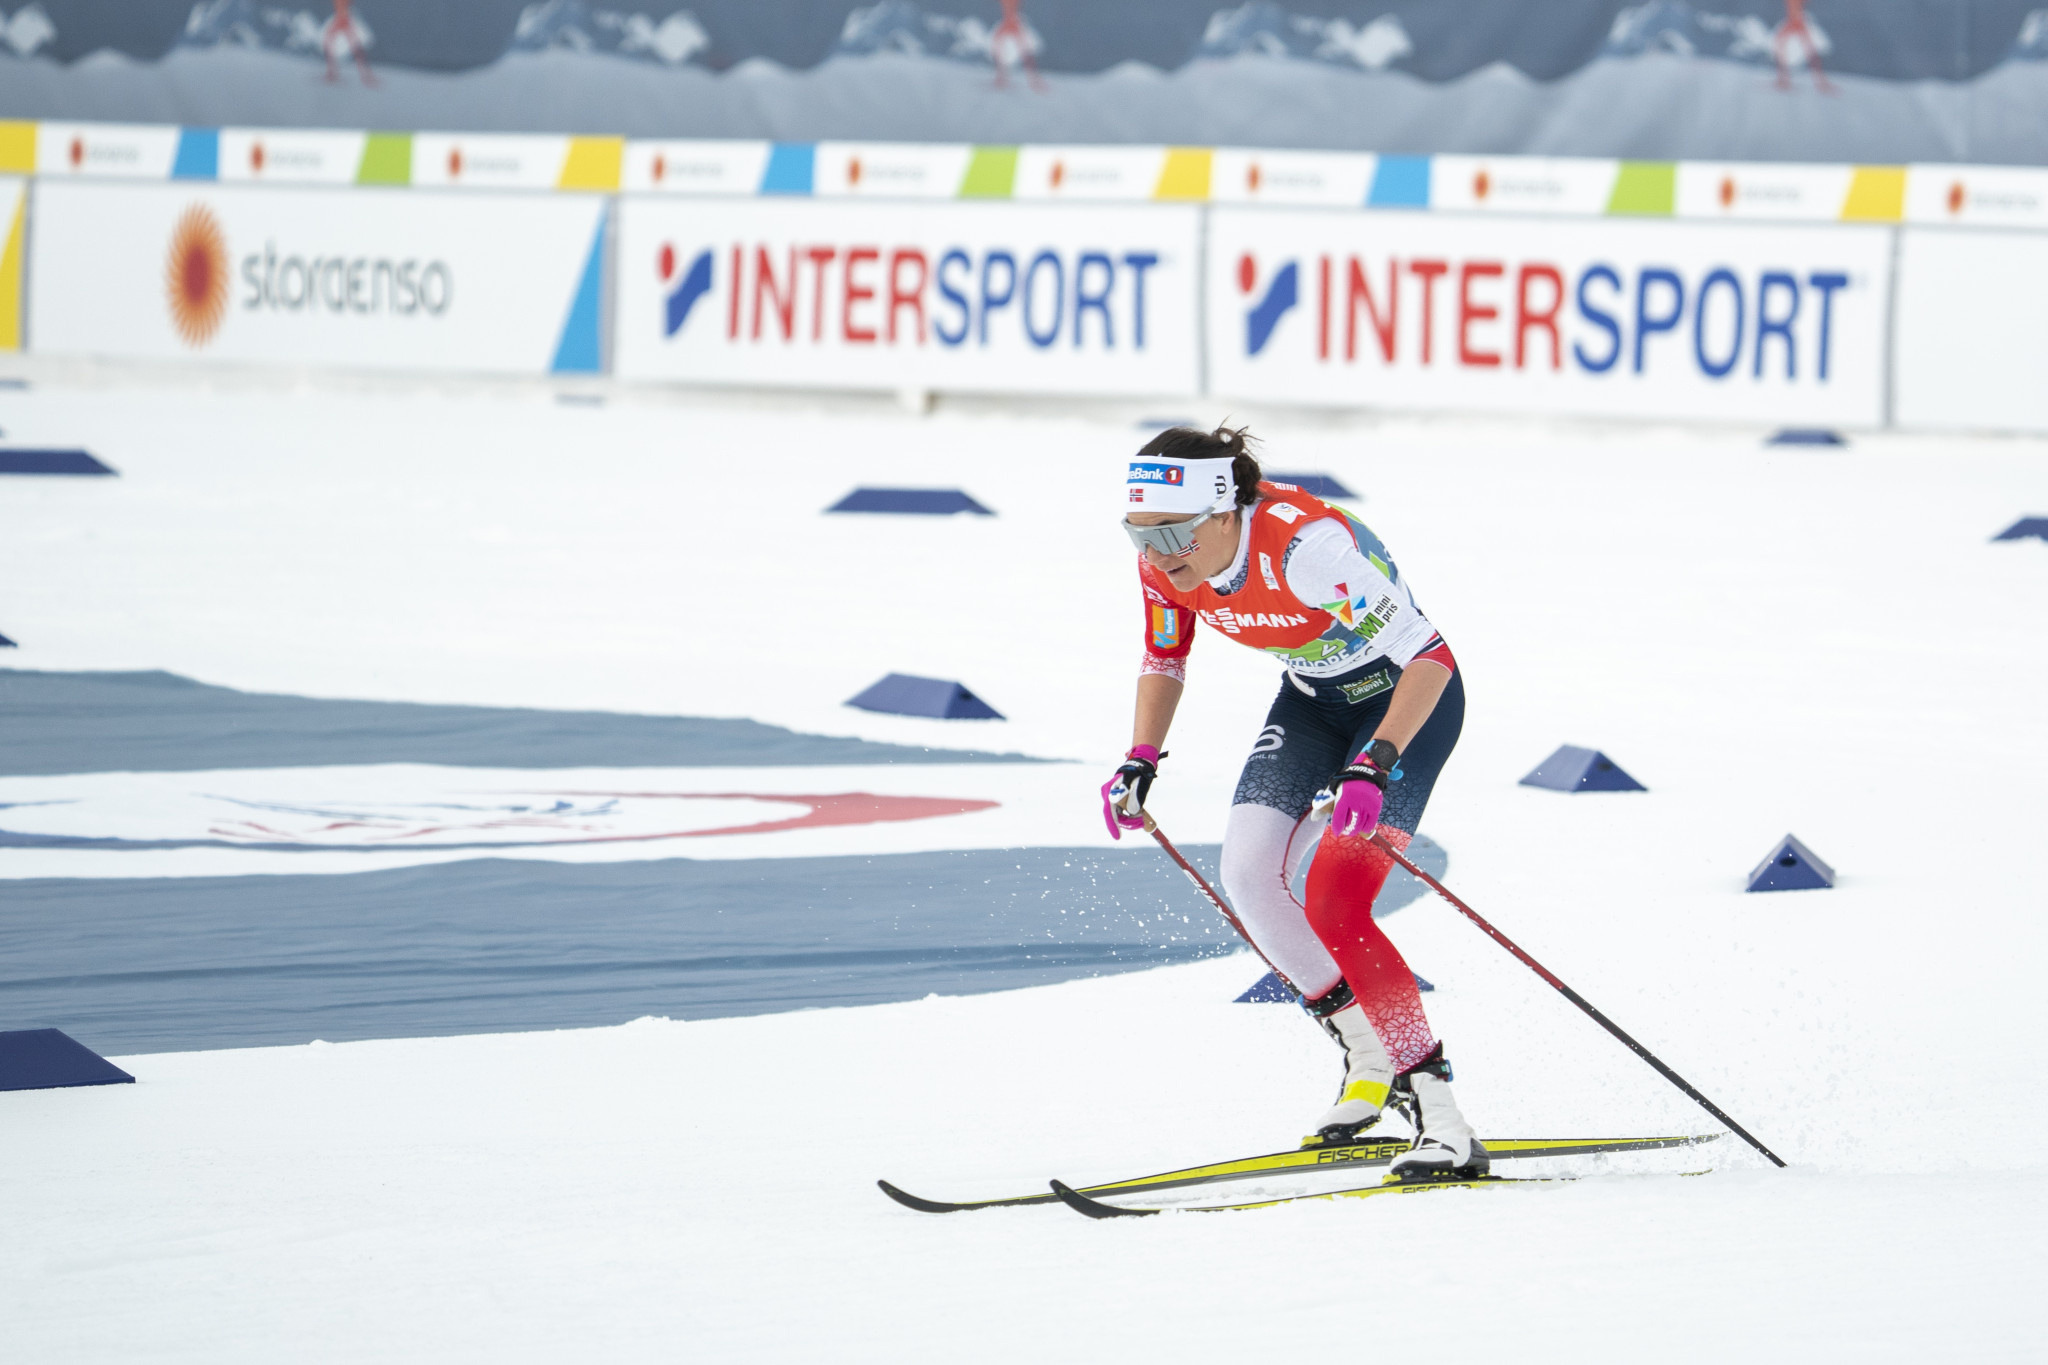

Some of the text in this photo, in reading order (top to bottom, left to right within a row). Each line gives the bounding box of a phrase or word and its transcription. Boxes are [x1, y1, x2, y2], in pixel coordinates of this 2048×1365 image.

[240, 241, 453, 318] storaenso
[727, 242, 1159, 351] INTERSPORT
[1317, 252, 1850, 383] INTERSPORT
[1128, 467, 1164, 481] eBank
[1375, 594, 1392, 616] mini
[1382, 603, 1398, 623] pris
[1317, 1144, 1410, 1164] FISCHER
